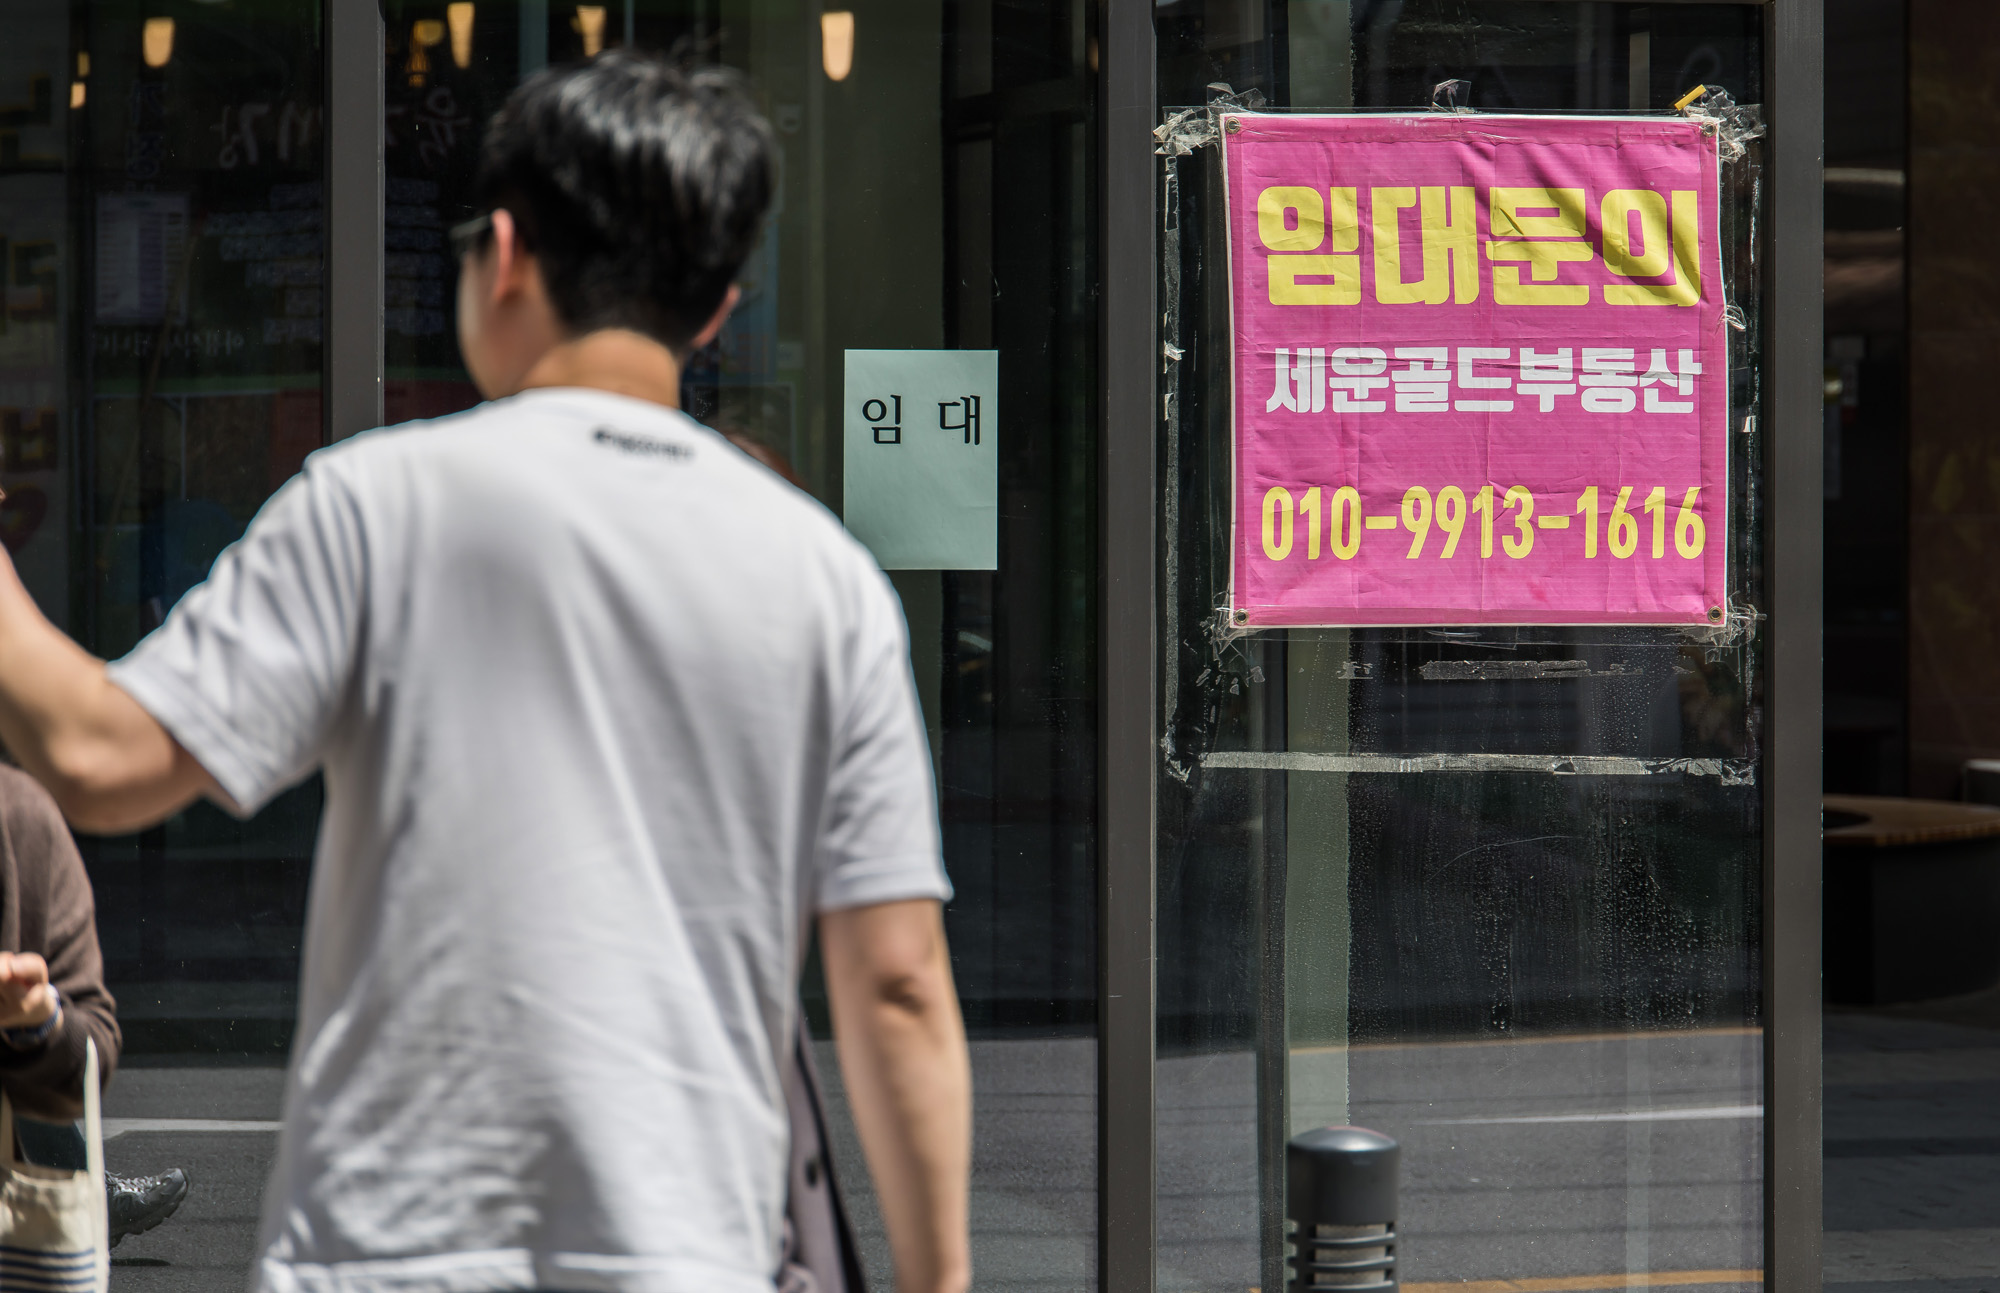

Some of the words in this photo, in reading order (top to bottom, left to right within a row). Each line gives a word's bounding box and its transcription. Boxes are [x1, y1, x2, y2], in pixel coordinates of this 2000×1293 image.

[1257, 186, 1702, 307] 임대문의
[1266, 347, 1702, 413] 세운골드부동산
[1261, 486, 1706, 560] 010-9913-1616
